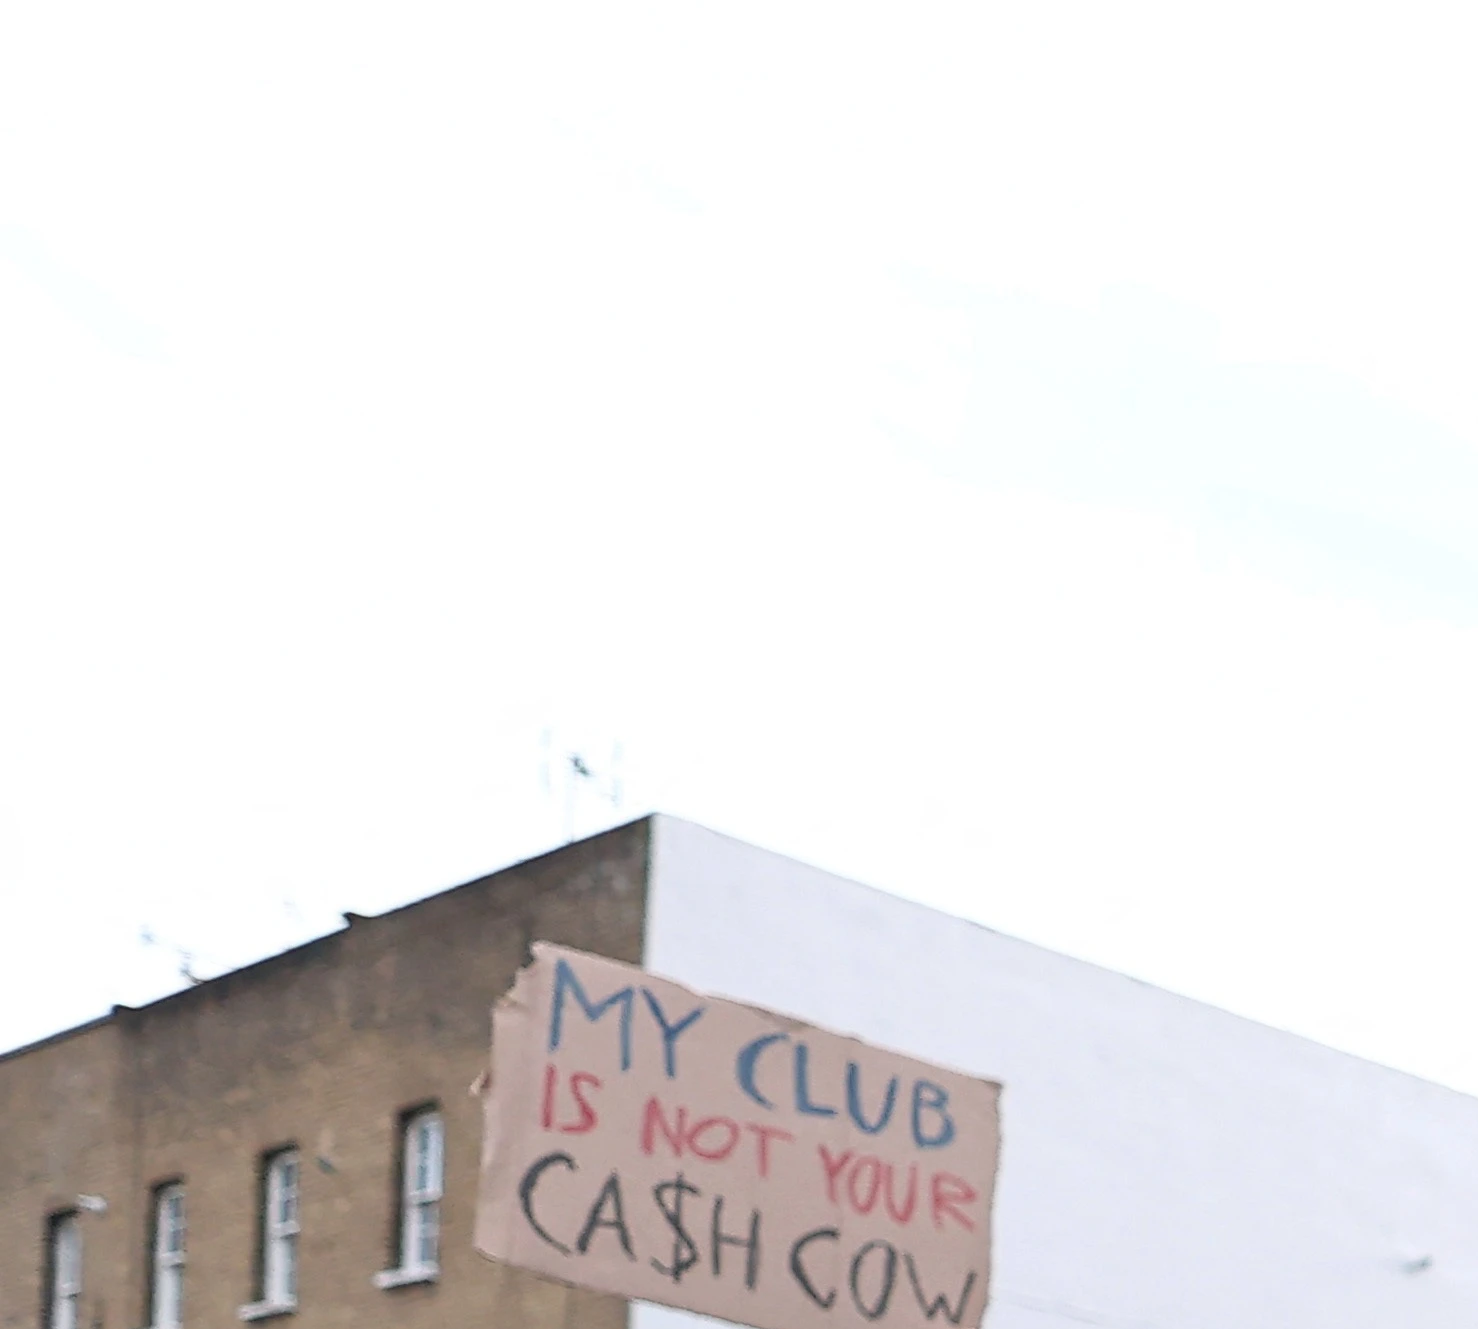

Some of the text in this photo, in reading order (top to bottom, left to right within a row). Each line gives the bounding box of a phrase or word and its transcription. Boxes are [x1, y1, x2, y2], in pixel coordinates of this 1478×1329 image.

[549, 957, 957, 1149] MY CLUB
[539, 1063, 979, 1232] IS NOT YOUR
[518, 1151, 977, 1324] CA$H COW
